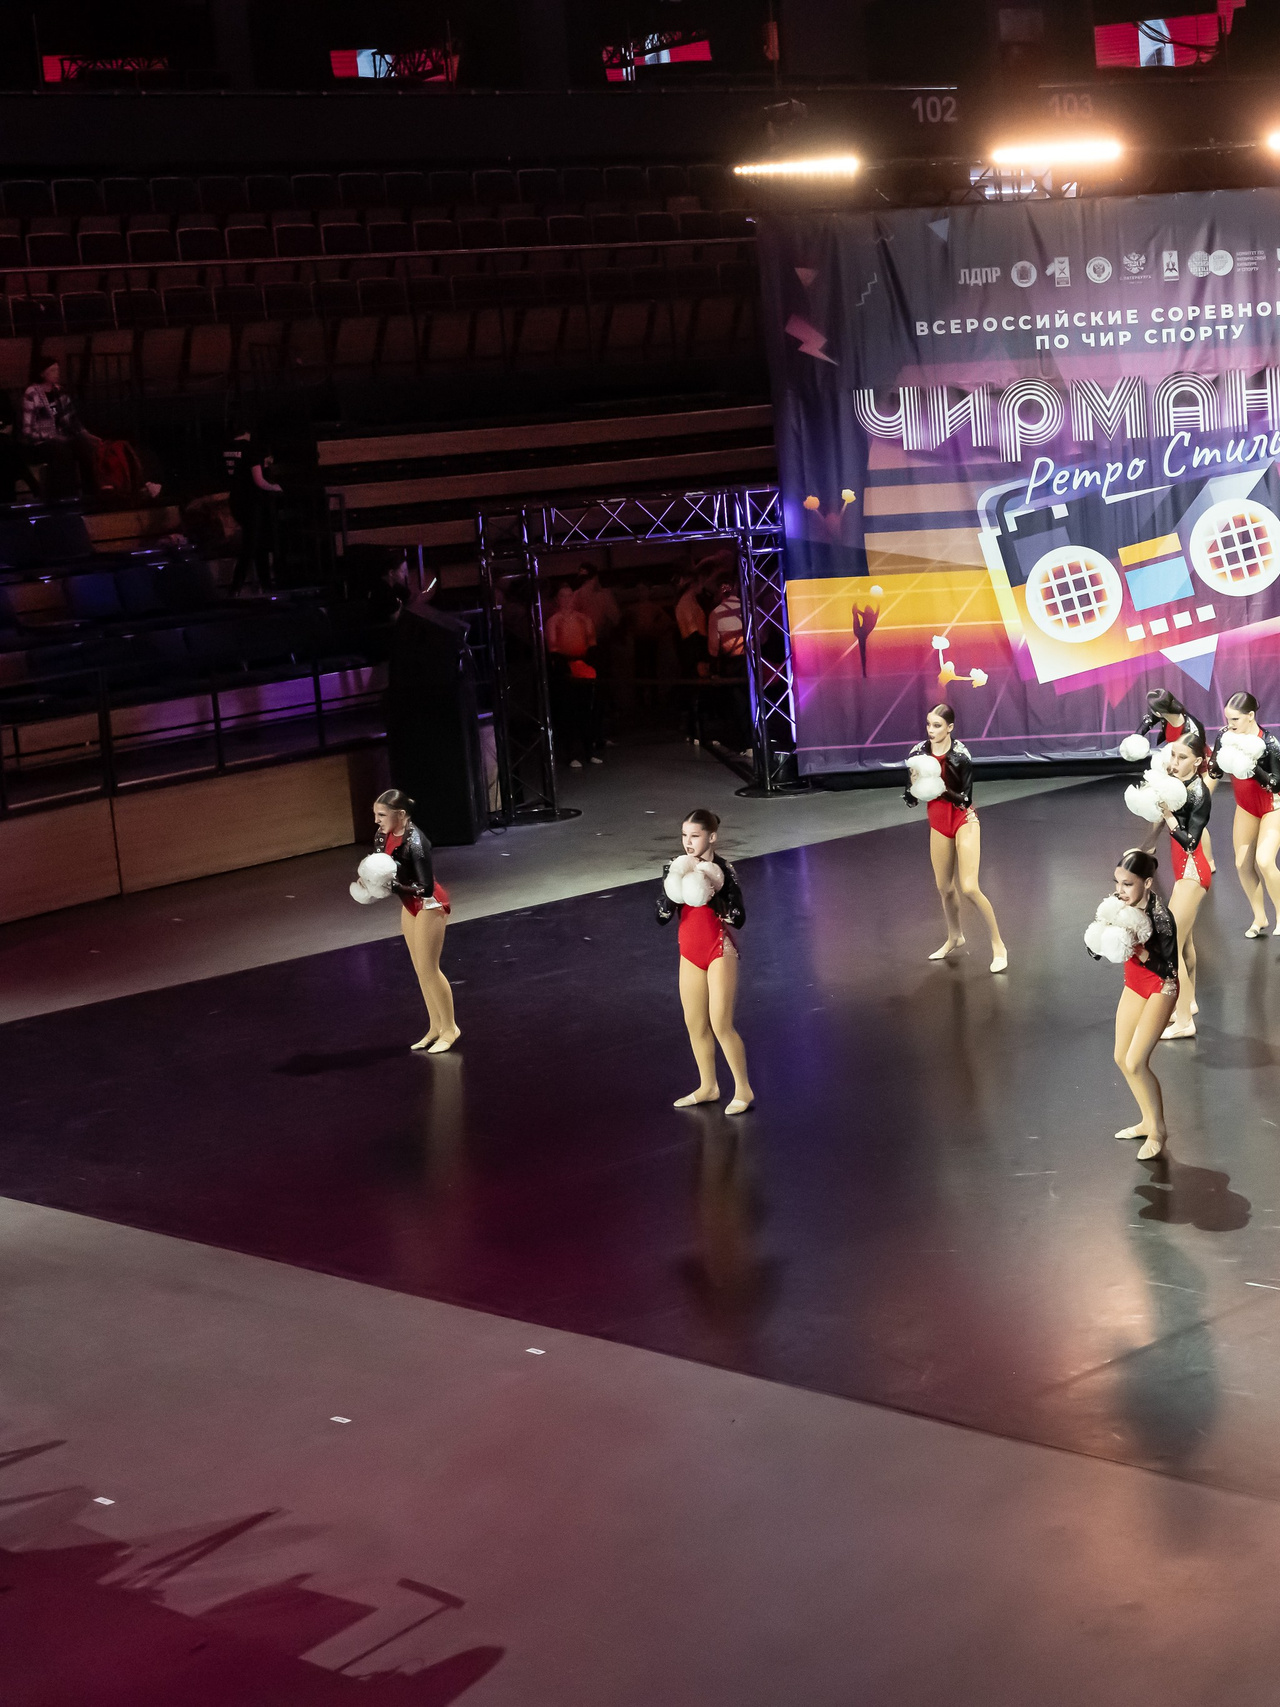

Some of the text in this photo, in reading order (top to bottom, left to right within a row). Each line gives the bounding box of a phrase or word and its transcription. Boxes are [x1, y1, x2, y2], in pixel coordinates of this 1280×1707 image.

[911, 96, 958, 123] 102
[1050, 92, 1094, 120] 103
[958, 267, 1001, 286] ЛДПР
[915, 309, 1139, 337] ВСЕРОССИЙСКИЕ
[1035, 323, 1246, 350] ПО ЧИР СПОРТУ
[1025, 456, 1147, 505] Ретро
